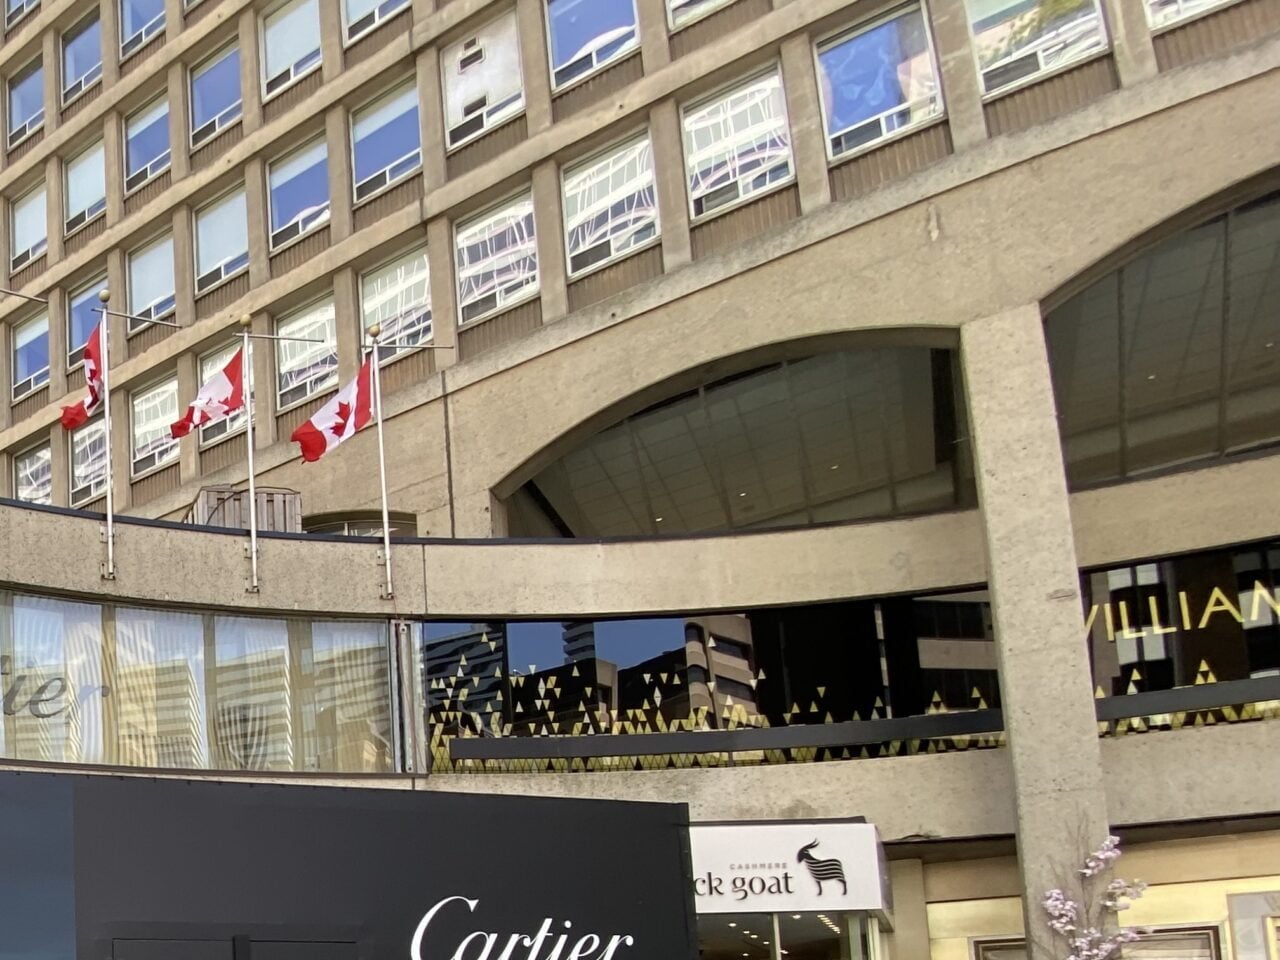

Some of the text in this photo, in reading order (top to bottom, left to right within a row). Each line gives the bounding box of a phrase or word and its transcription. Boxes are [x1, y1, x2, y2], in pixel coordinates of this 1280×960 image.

[729, 862, 787, 870] CASHMERE
[693, 871, 794, 901] ck goat
